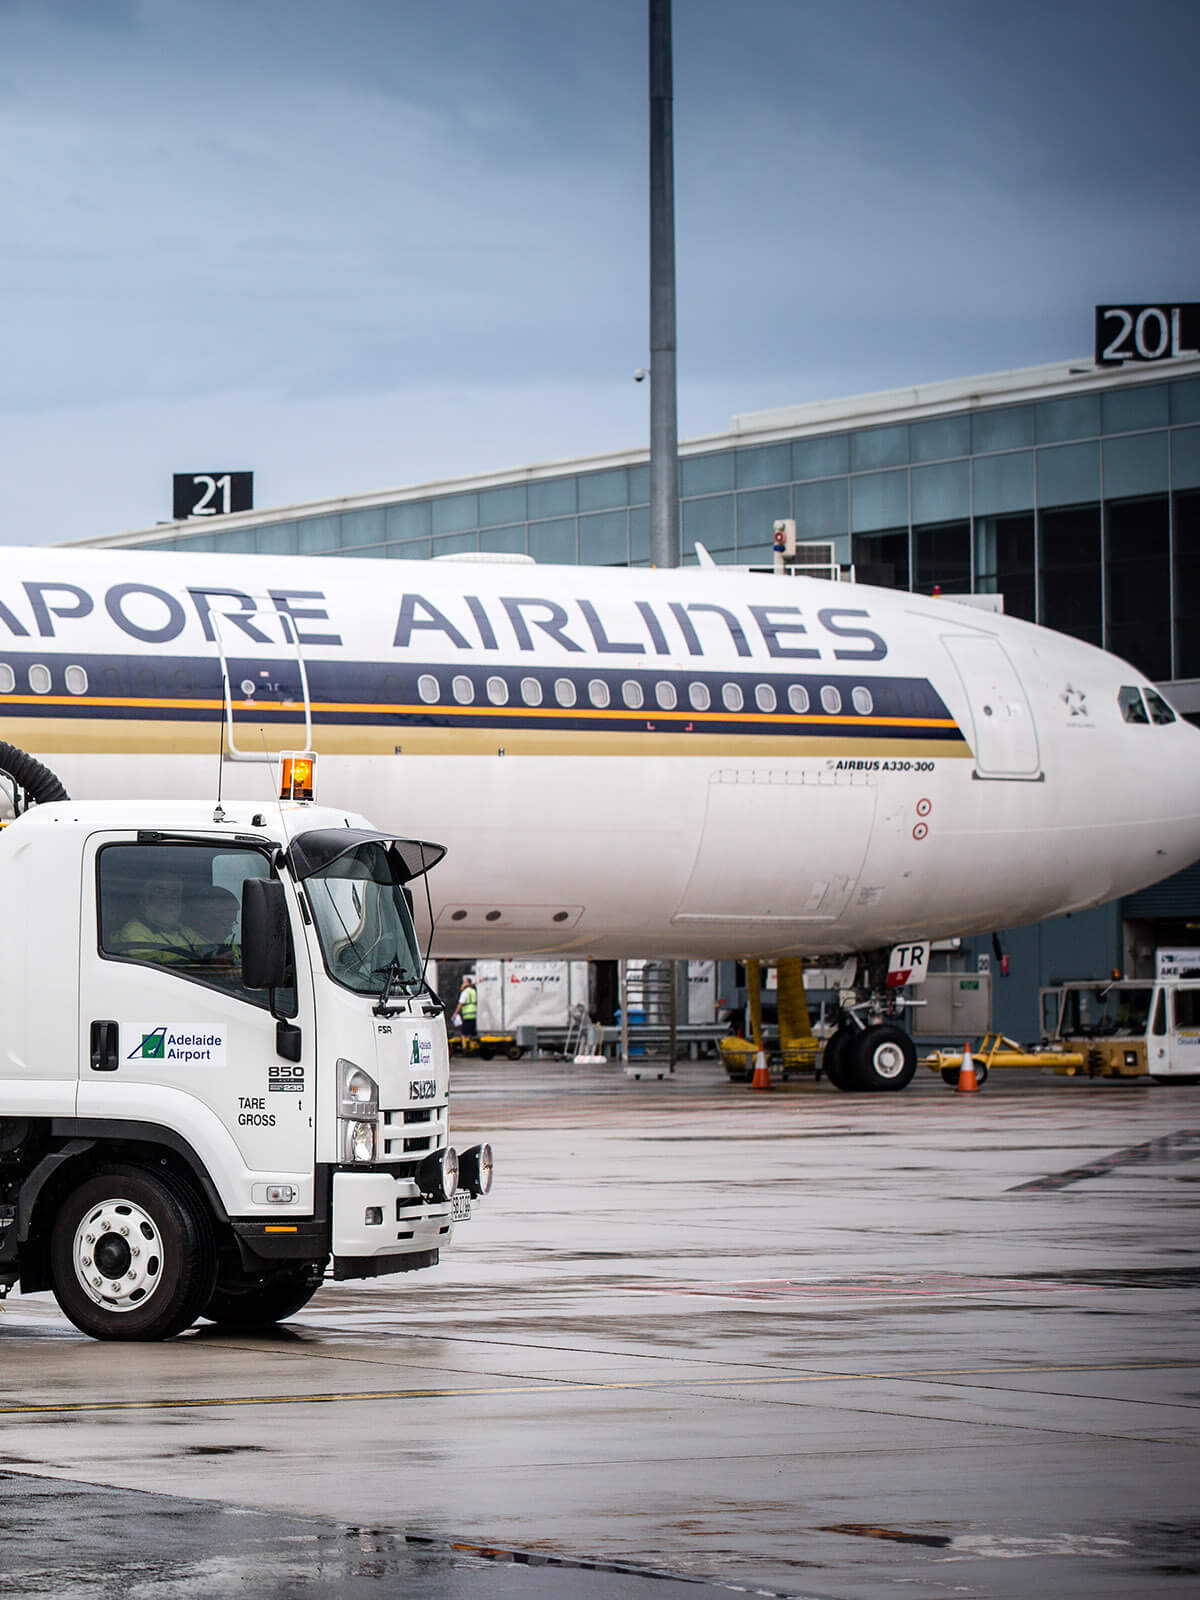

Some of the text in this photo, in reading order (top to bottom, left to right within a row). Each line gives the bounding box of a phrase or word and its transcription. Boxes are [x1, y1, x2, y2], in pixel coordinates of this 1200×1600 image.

[1103, 308, 1199, 358] 20L
[192, 475, 231, 514] 21
[392, 593, 888, 661] AIRLINES
[836, 760, 935, 771] AIRBUS A330-300
[897, 946, 924, 967] TR
[378, 1025, 392, 1034] FSR
[167, 1034, 222, 1046] Adelaide
[167, 1048, 211, 1062] Airport
[268, 1067, 304, 1077] 850
[409, 1080, 437, 1100] ISUZU
[238, 1097, 266, 1110] TARE
[238, 1113, 277, 1126] GROSS
